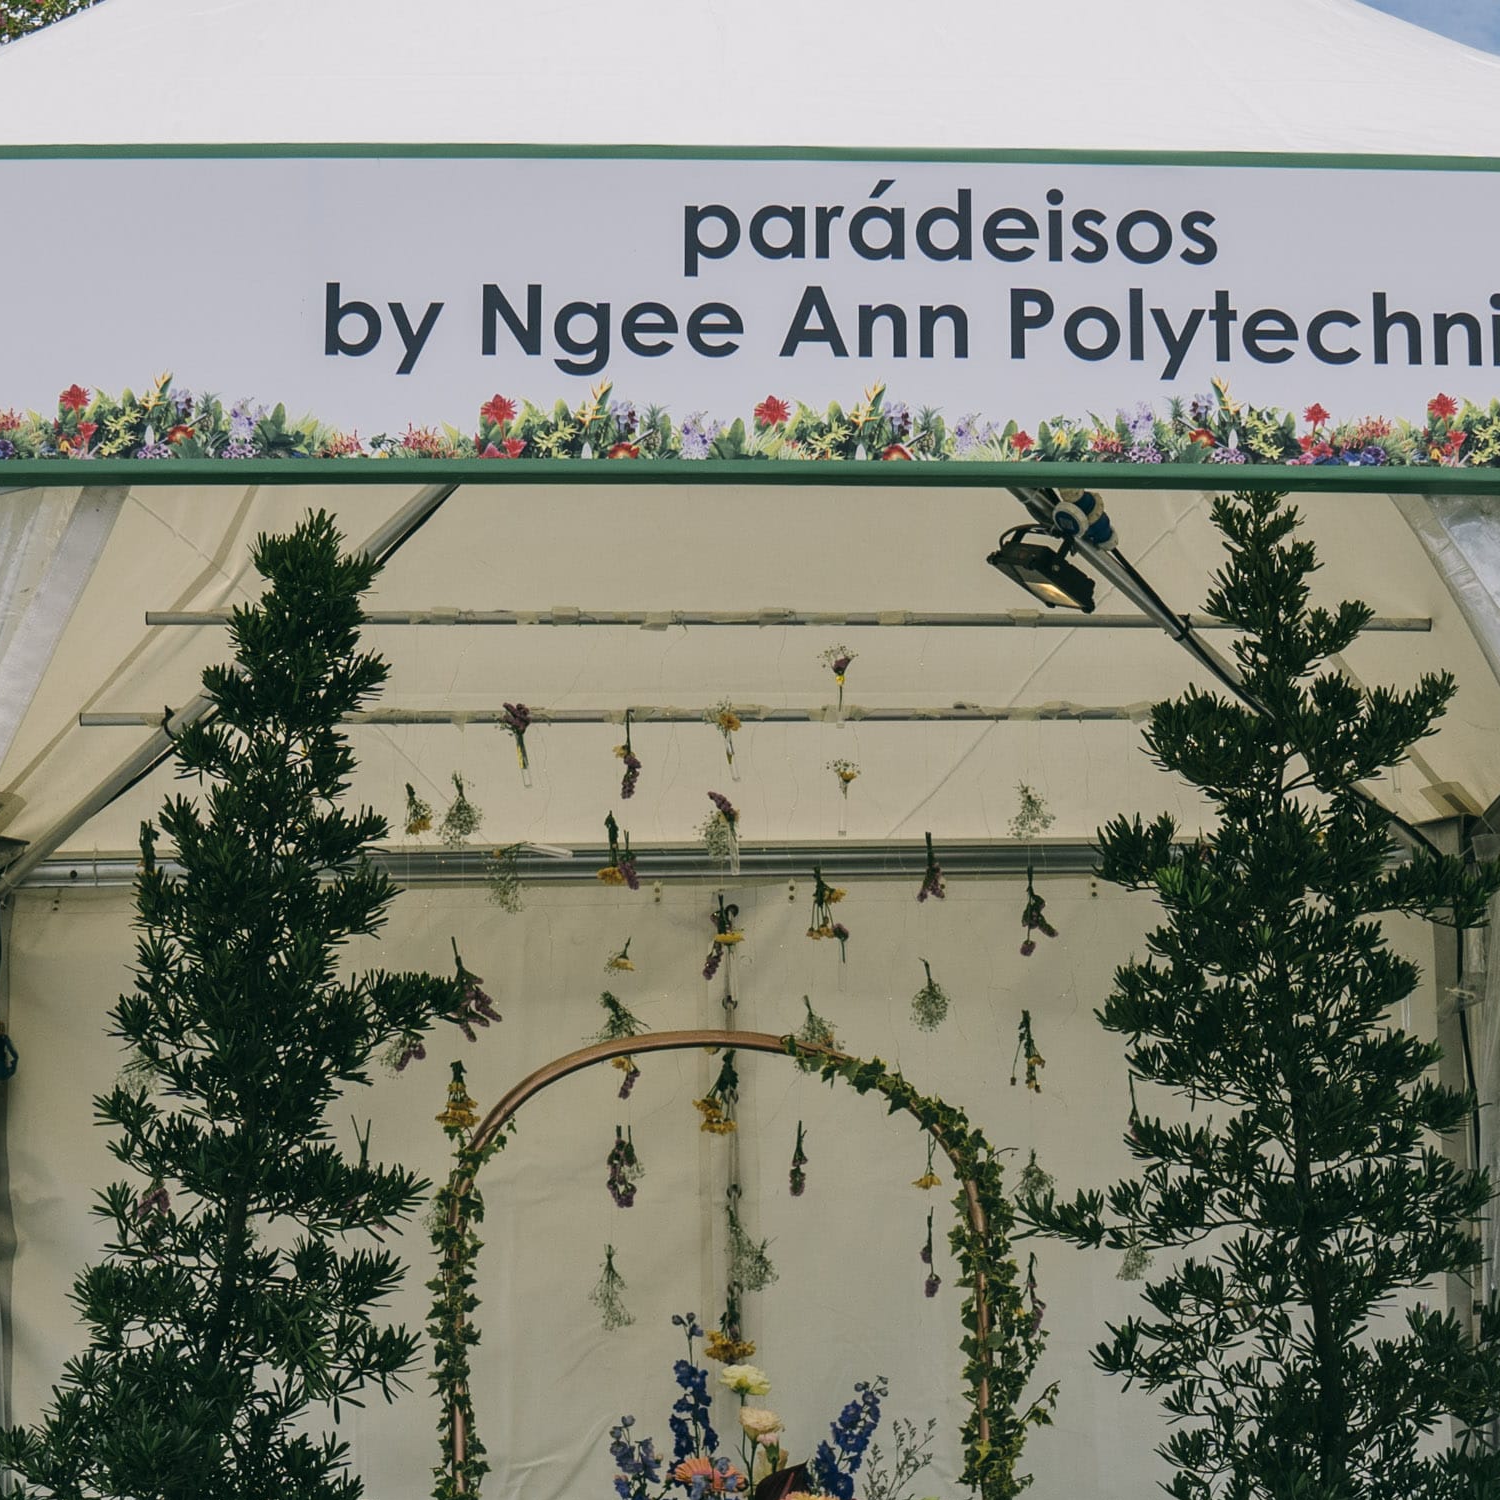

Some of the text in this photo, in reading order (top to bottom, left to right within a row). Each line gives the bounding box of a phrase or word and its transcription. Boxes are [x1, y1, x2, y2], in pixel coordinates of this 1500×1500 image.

[685, 180, 1218, 278] parádeisos
[324, 282, 445, 375] by
[481, 283, 744, 377] Ngee
[779, 285, 969, 359] Ann
